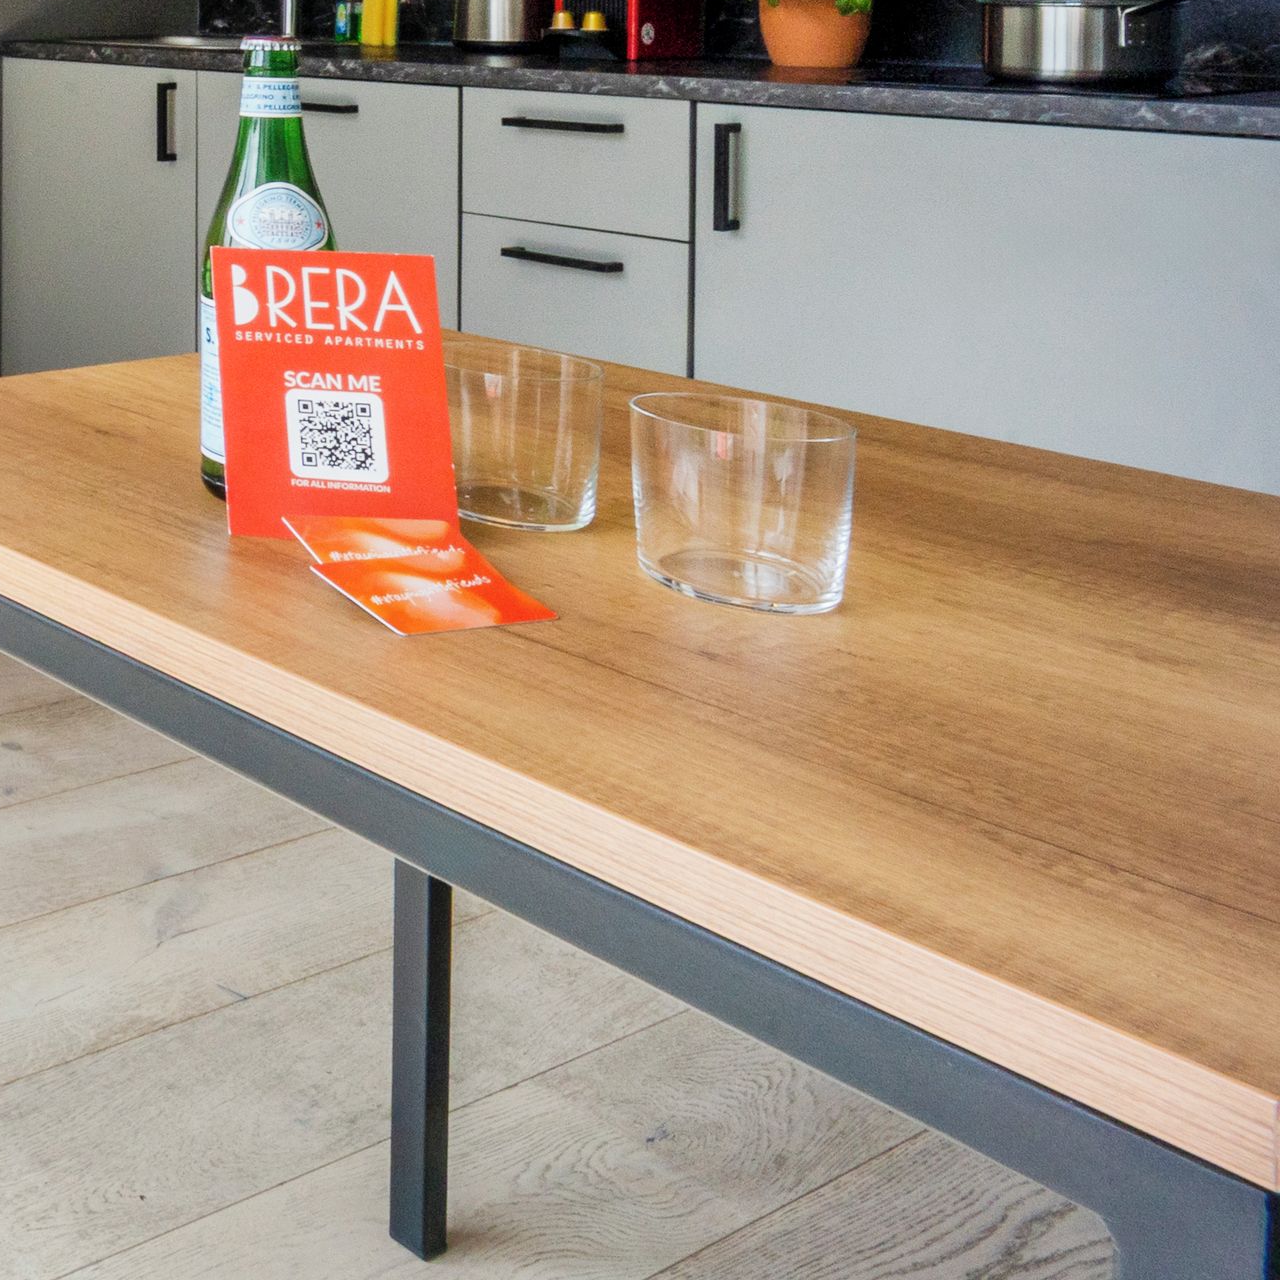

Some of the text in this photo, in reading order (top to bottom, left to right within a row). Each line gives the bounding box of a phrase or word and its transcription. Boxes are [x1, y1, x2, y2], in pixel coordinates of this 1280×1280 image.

[231, 263, 423, 335] BRERA
[235, 330, 425, 351] SERVICED APARTMENTS
[283, 370, 382, 393] SCAN ME
[291, 478, 392, 494] FOR ALL INFORMATION
